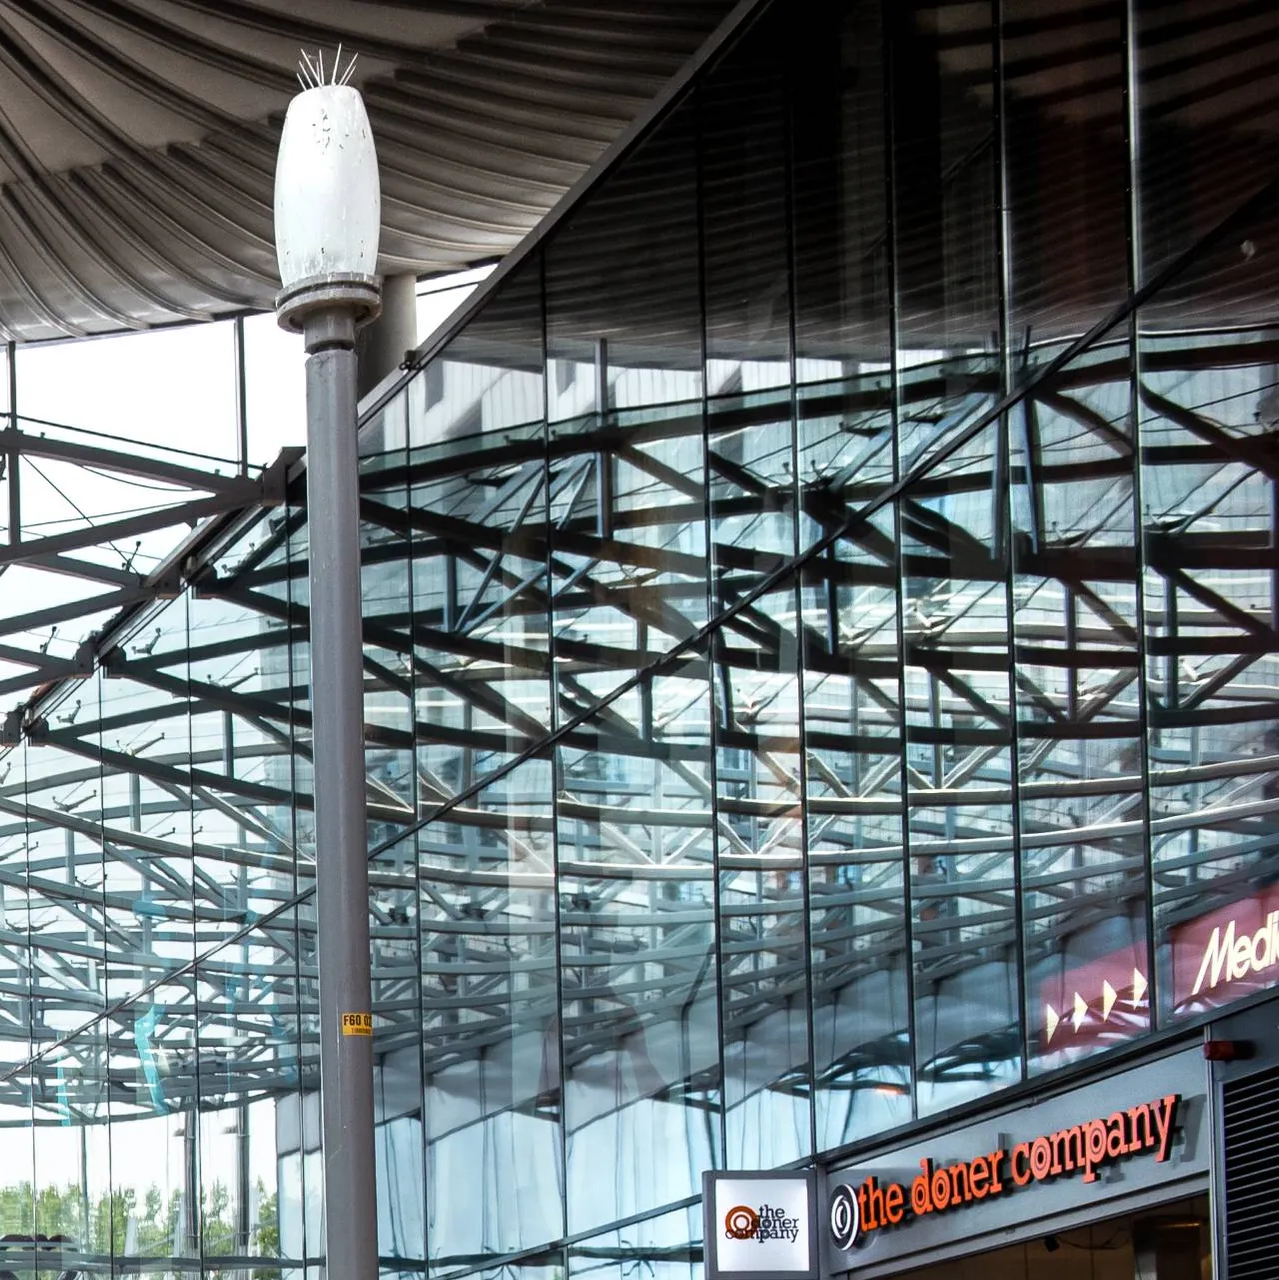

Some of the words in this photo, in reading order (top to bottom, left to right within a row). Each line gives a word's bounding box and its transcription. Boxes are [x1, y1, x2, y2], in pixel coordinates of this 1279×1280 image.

[1192, 910, 1279, 996] Medi
[859, 1176, 904, 1232] the
[912, 1150, 1003, 1216] doner
[1012, 1094, 1177, 1184] company
[759, 1204, 785, 1219] the
